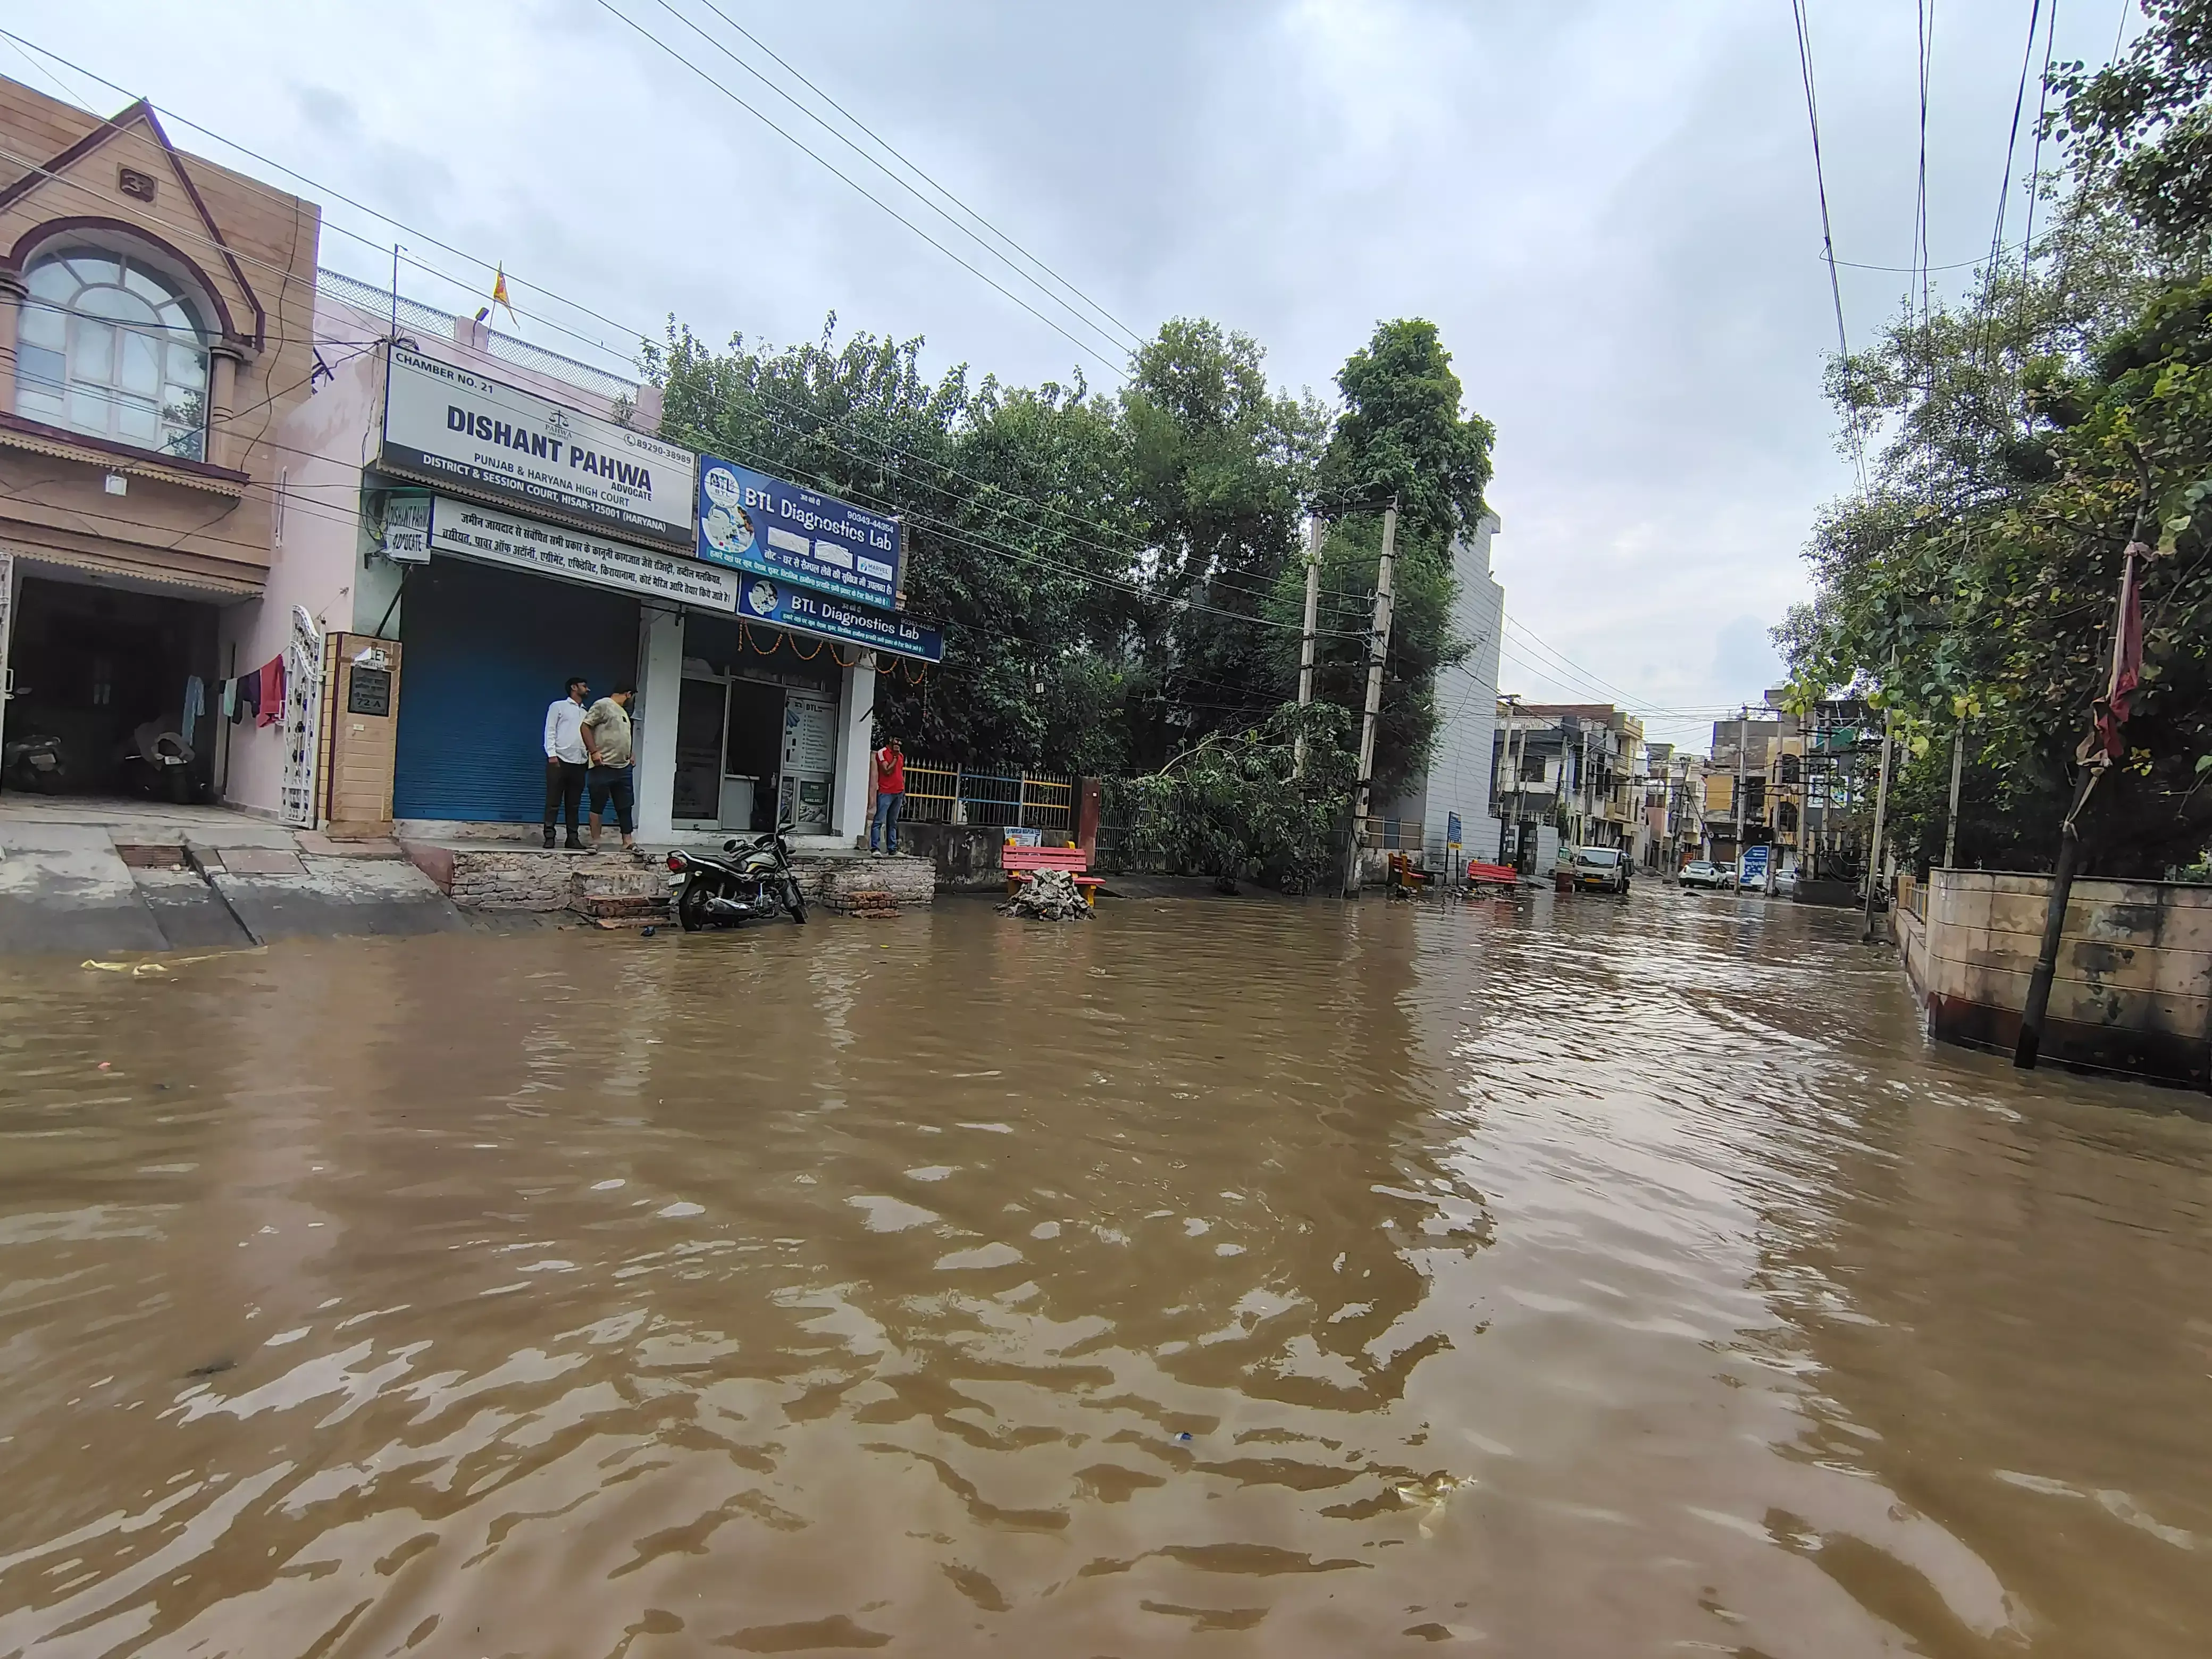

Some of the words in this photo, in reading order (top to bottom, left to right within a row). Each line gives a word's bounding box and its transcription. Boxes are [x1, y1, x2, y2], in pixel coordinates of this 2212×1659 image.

[396, 353, 454, 380] CHAMBER
[458, 374, 477, 389] NO.
[481, 382, 493, 394] 21
[447, 405, 563, 463] DISHANT
[569, 445, 652, 492] PAHWA
[545, 424, 572, 439] PAHWA
[636, 439, 691, 464] 89290-38989
[423, 454, 470, 476] DISTRICT
[472, 469, 480, 479] &
[482, 471, 525, 492] SESSION
[526, 483, 559, 503] COURT,
[562, 495, 620, 519] HISAR-125001
[623, 511, 666, 533] (HARYANA)
[474, 453, 514, 472] PUNJAB
[517, 466, 525, 475] &
[527, 468, 573, 491] HARYANA
[575, 483, 598, 498] HIGH
[601, 491, 630, 507] COURT
[611, 482, 652, 501] ADVOCATE
[715, 489, 730, 497] BTL
[460, 513, 484, 527] जमीन
[484, 519, 514, 535] जायदाद
[515, 524, 522, 537] से
[549, 535, 564, 548] सभी
[565, 539, 583, 552] प्रकार
[584, 542, 591, 554] के
[592, 546, 614, 561] कानूनी
[615, 551, 640, 566] कागजात
[641, 556, 652, 569] जैसे
[745, 487, 775, 513] BTL
[781, 499, 865, 542] Diagnostics
[870, 529, 892, 551] Lab
[474, 535, 493, 549] पावर
[494, 539, 511, 553] ऑफ
[639, 573, 652, 585] कोर्ट
[653, 575, 668, 589] मैरिज
[669, 581, 683, 592] आदि
[684, 583, 698, 596] तैयार
[699, 586, 711, 598] किये
[712, 590, 723, 601] जाते
[764, 549, 776, 561] नोट
[783, 555, 793, 566] घर
[793, 557, 800, 568] से
[820, 565, 832, 577] लेने
[832, 569, 841, 580] की
[842, 572, 858, 584] सुविधा
[858, 576, 866, 587] भी
[867, 580, 885, 593] उपलब्ध
[868, 563, 889, 574] MARVEL
[791, 596, 816, 614] BTL
[822, 604, 895, 634] Diagnostics
[900, 624, 919, 640] Lab
